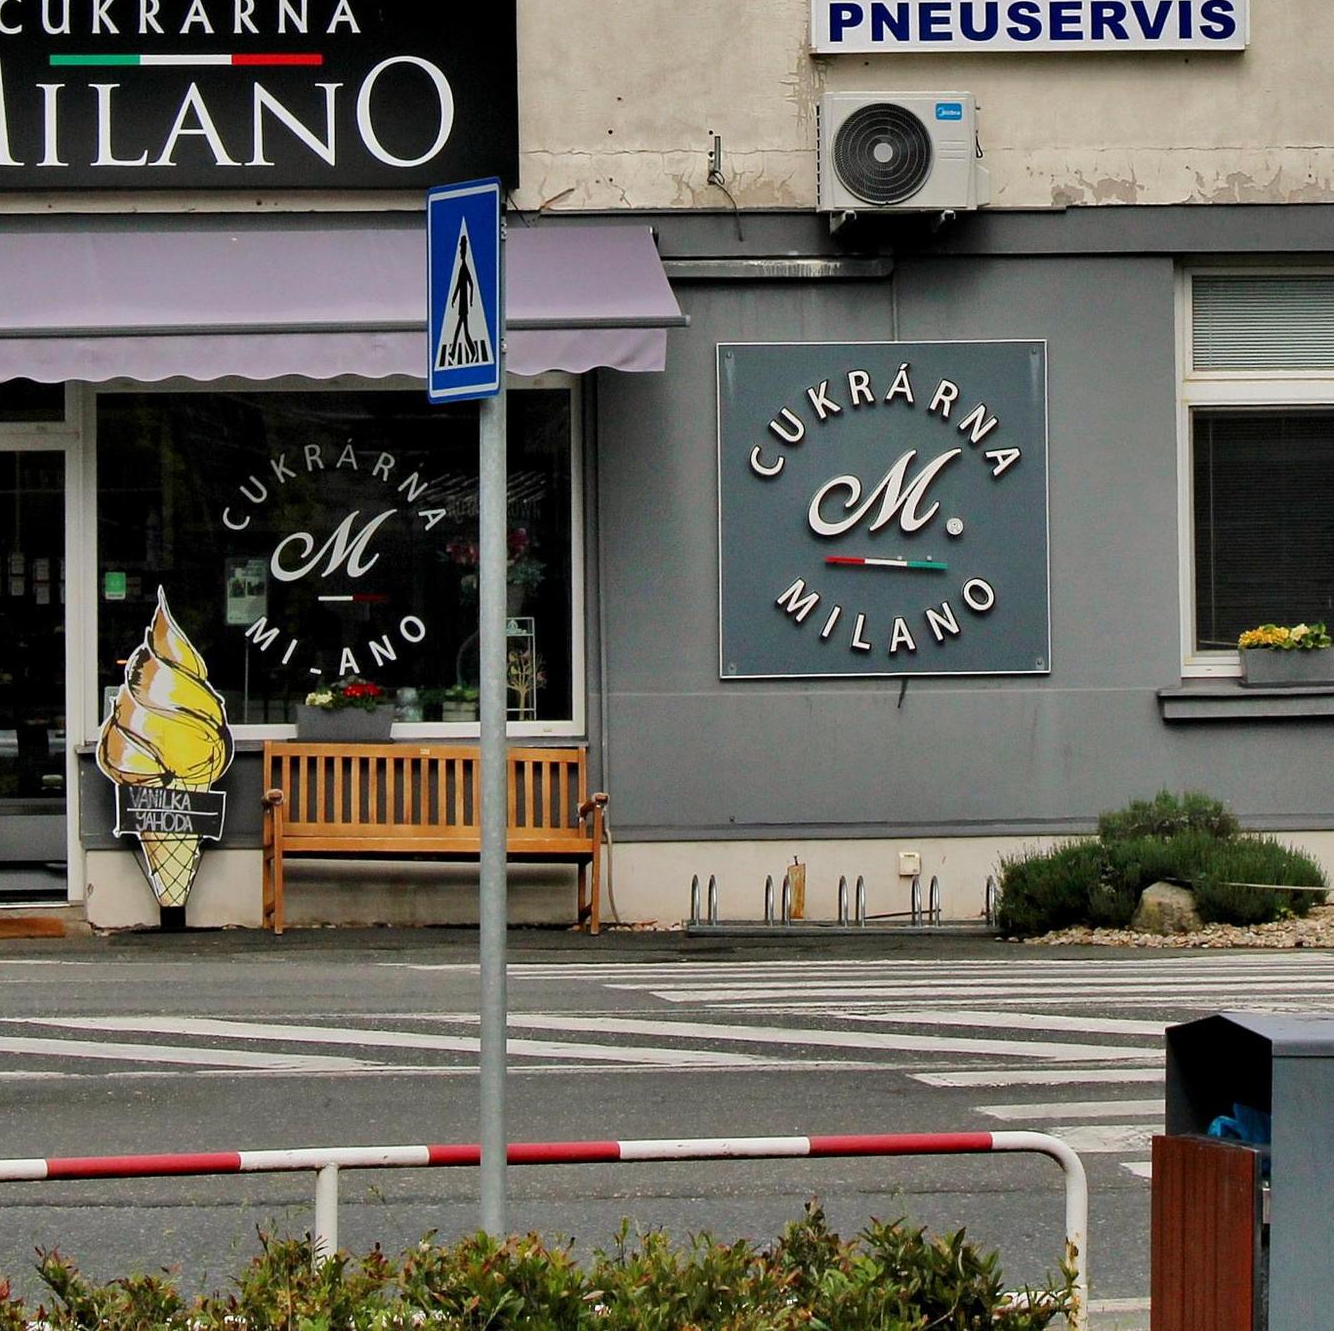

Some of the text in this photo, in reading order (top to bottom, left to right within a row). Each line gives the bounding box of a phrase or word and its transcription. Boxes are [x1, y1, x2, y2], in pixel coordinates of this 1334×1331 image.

[749, 362, 1021, 477] CUKRÁRNA
[223, 437, 447, 531] CUKRÁRNA
[244, 615, 427, 676] MIANO
[776, 577, 996, 654] MILANO
